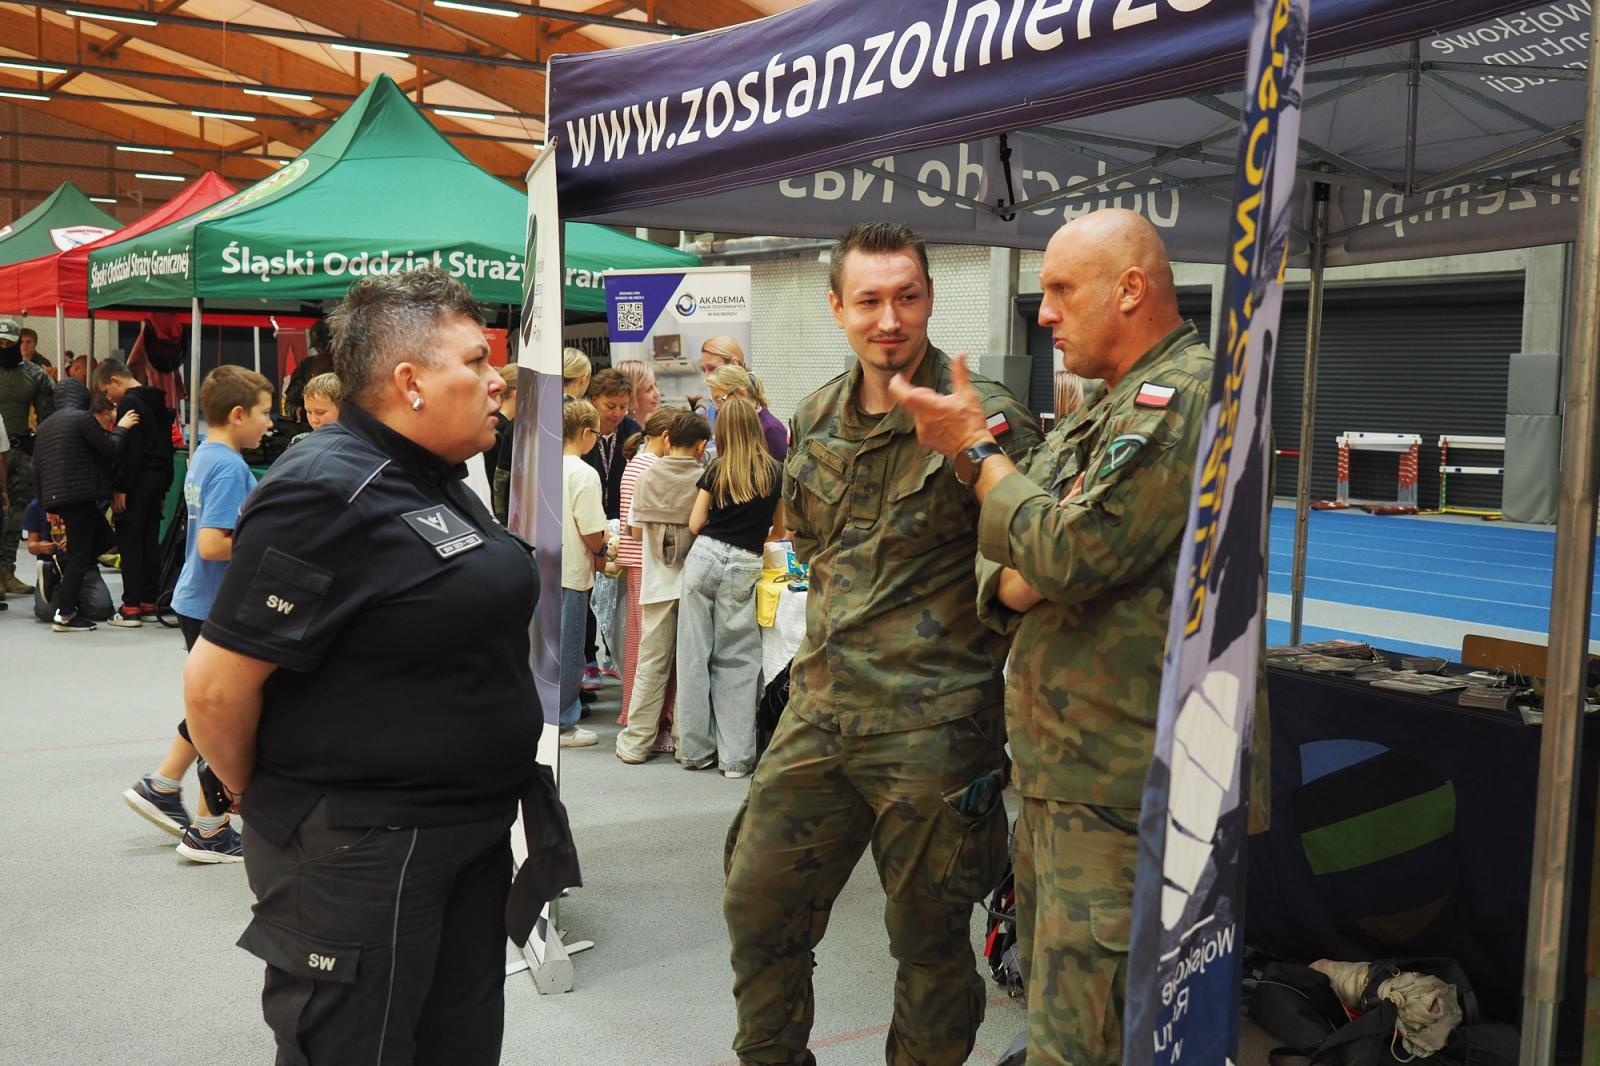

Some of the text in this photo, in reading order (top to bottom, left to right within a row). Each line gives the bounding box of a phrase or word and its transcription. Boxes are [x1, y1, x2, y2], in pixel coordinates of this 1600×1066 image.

[567, 0, 1214, 168] www.zostanzolnier
[151, 244, 190, 280] Granicznej
[221, 241, 315, 283] Śląski
[323, 249, 442, 276] Oddział
[449, 251, 527, 290] Straż
[699, 296, 746, 304] AKADEMIA
[266, 594, 296, 615] SW
[308, 953, 336, 971] SW
